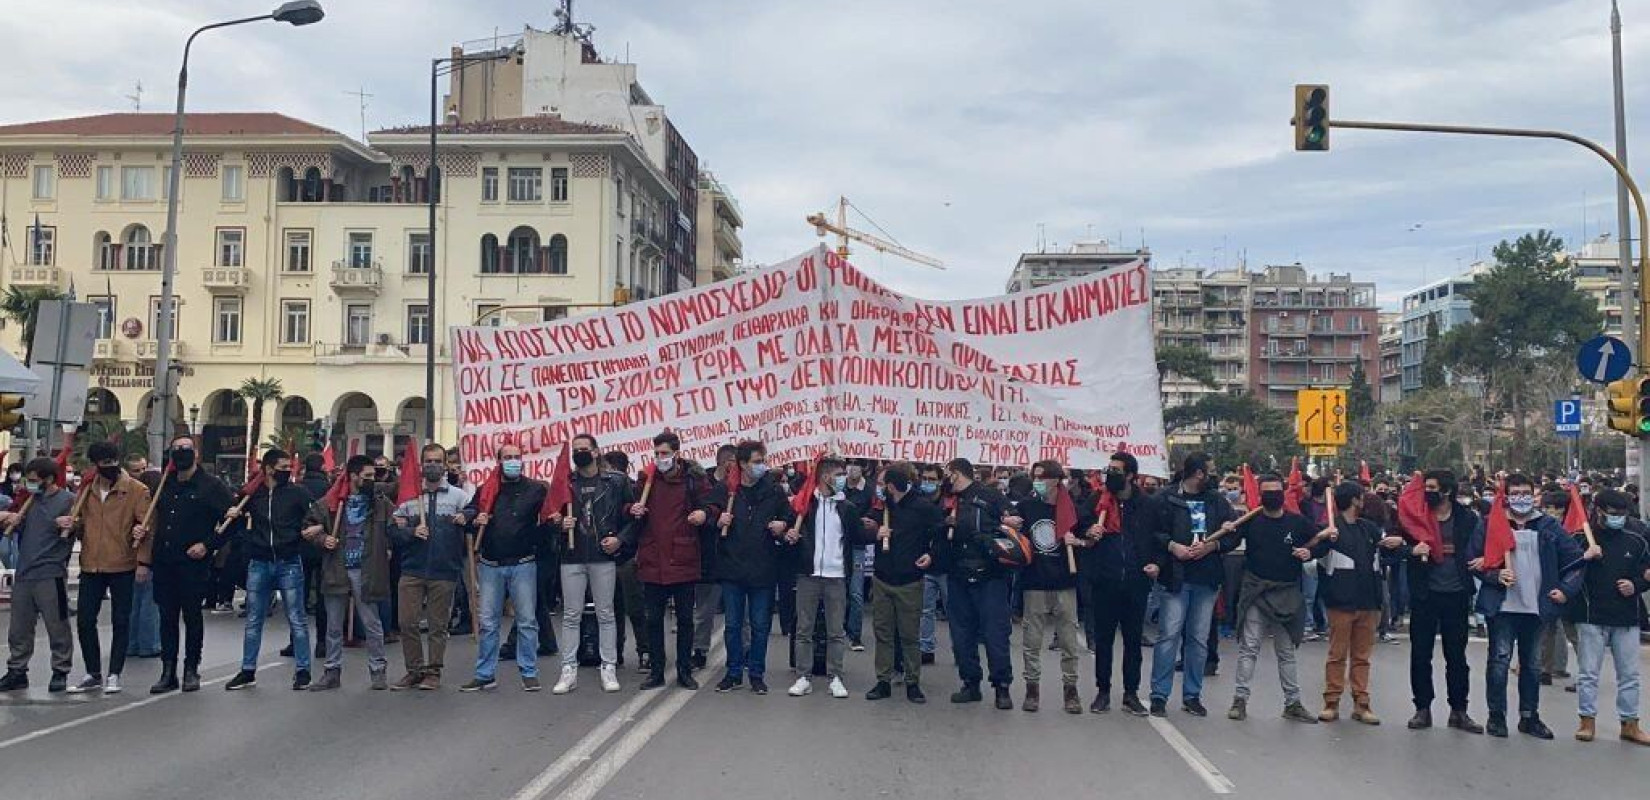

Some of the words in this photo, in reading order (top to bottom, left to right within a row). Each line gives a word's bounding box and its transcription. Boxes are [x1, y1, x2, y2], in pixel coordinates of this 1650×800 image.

[457, 328, 493, 363] ΝΑ
[494, 318, 613, 359] ΑΠΟΣΥΡΘΕΙ
[617, 310, 645, 343] ΤΟ
[963, 300, 1017, 335] ΕΙΝΑΙ
[1024, 264, 1148, 332] ΕΓΚΛΗΜΑΤΙΕΣ
[460, 366, 492, 395] ΟΧΙ
[500, 362, 526, 391] ΣΕ
[531, 353, 650, 388] ΠΑΝΕΠΙΣΤΗΜΙΑΚΗ
[732, 304, 810, 341] ΠΕΙΘΑΡΧΙΚΑ
[463, 391, 551, 427] ΑΝΟΙΓΜΑ
[756, 335, 789, 368] ΜΕ
[795, 325, 833, 357] ΟΛΑ
[837, 322, 858, 352] ΤΑ
[873, 325, 940, 359] ΜΕΤΡΑ
[541, 420, 570, 447] ΔΕΝ
[571, 397, 664, 437] ΜΠΑΙΝΟΥΝ
[674, 385, 716, 418] ΣΤΟ
[1562, 401, 1575, 423] P
